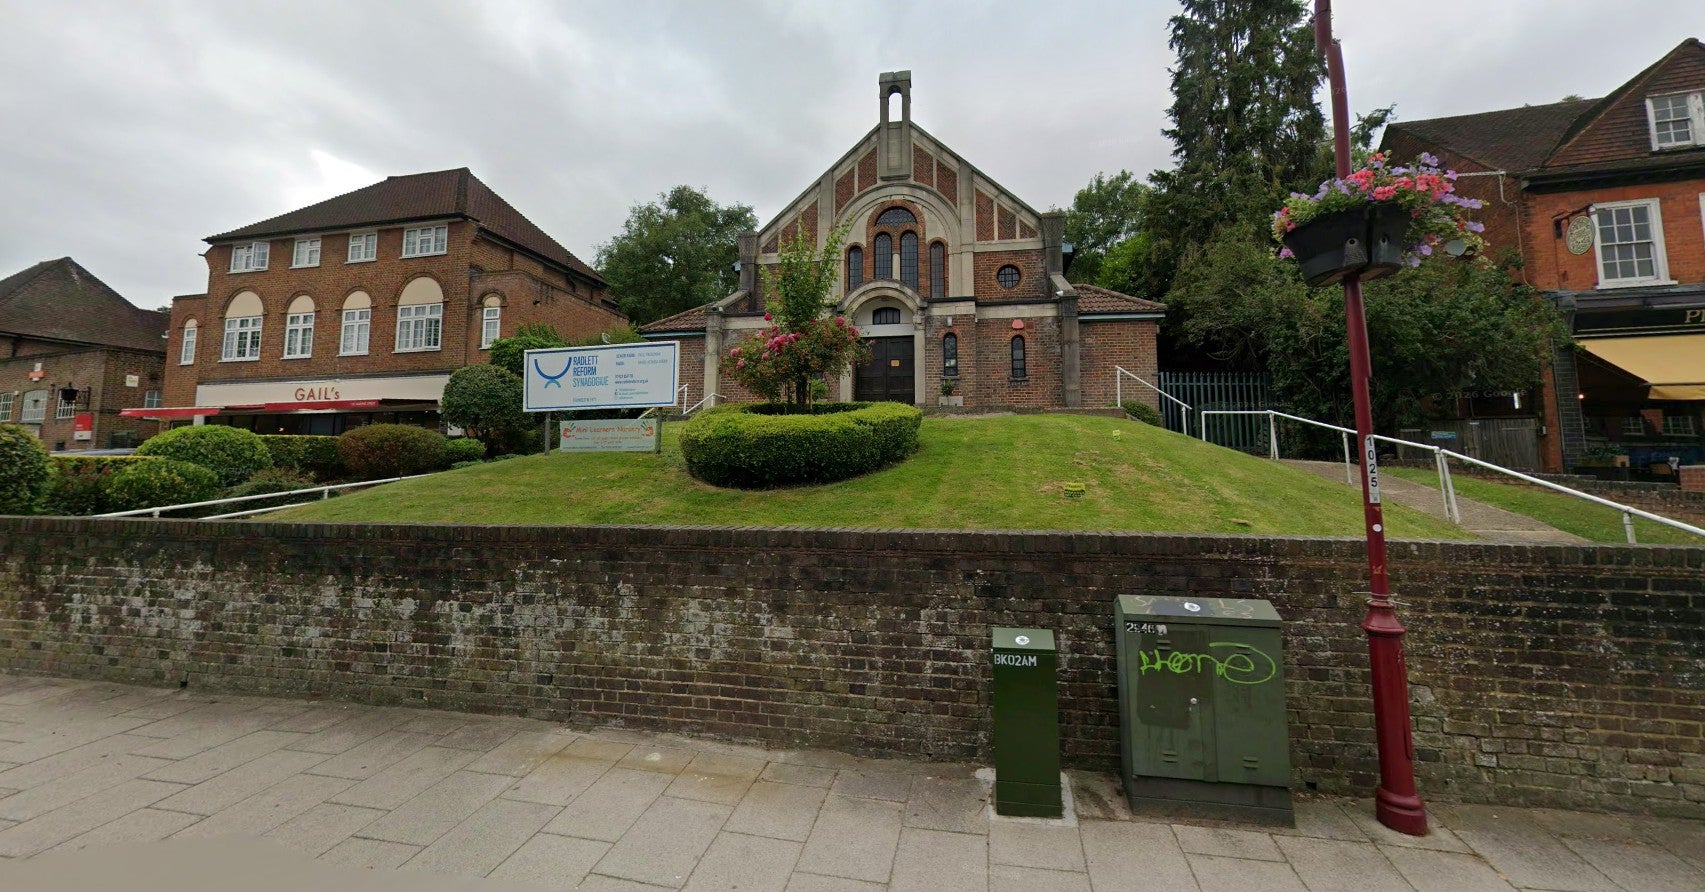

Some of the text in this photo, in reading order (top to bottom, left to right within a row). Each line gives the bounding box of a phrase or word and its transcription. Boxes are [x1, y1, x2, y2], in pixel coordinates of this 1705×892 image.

[573, 355, 599, 366] RADLETT
[573, 366, 597, 376] REFORM
[573, 376, 609, 388] SYNAGOGUE
[295, 387, 340, 401] GAIL's
[1367, 437, 1378, 487] 1025
